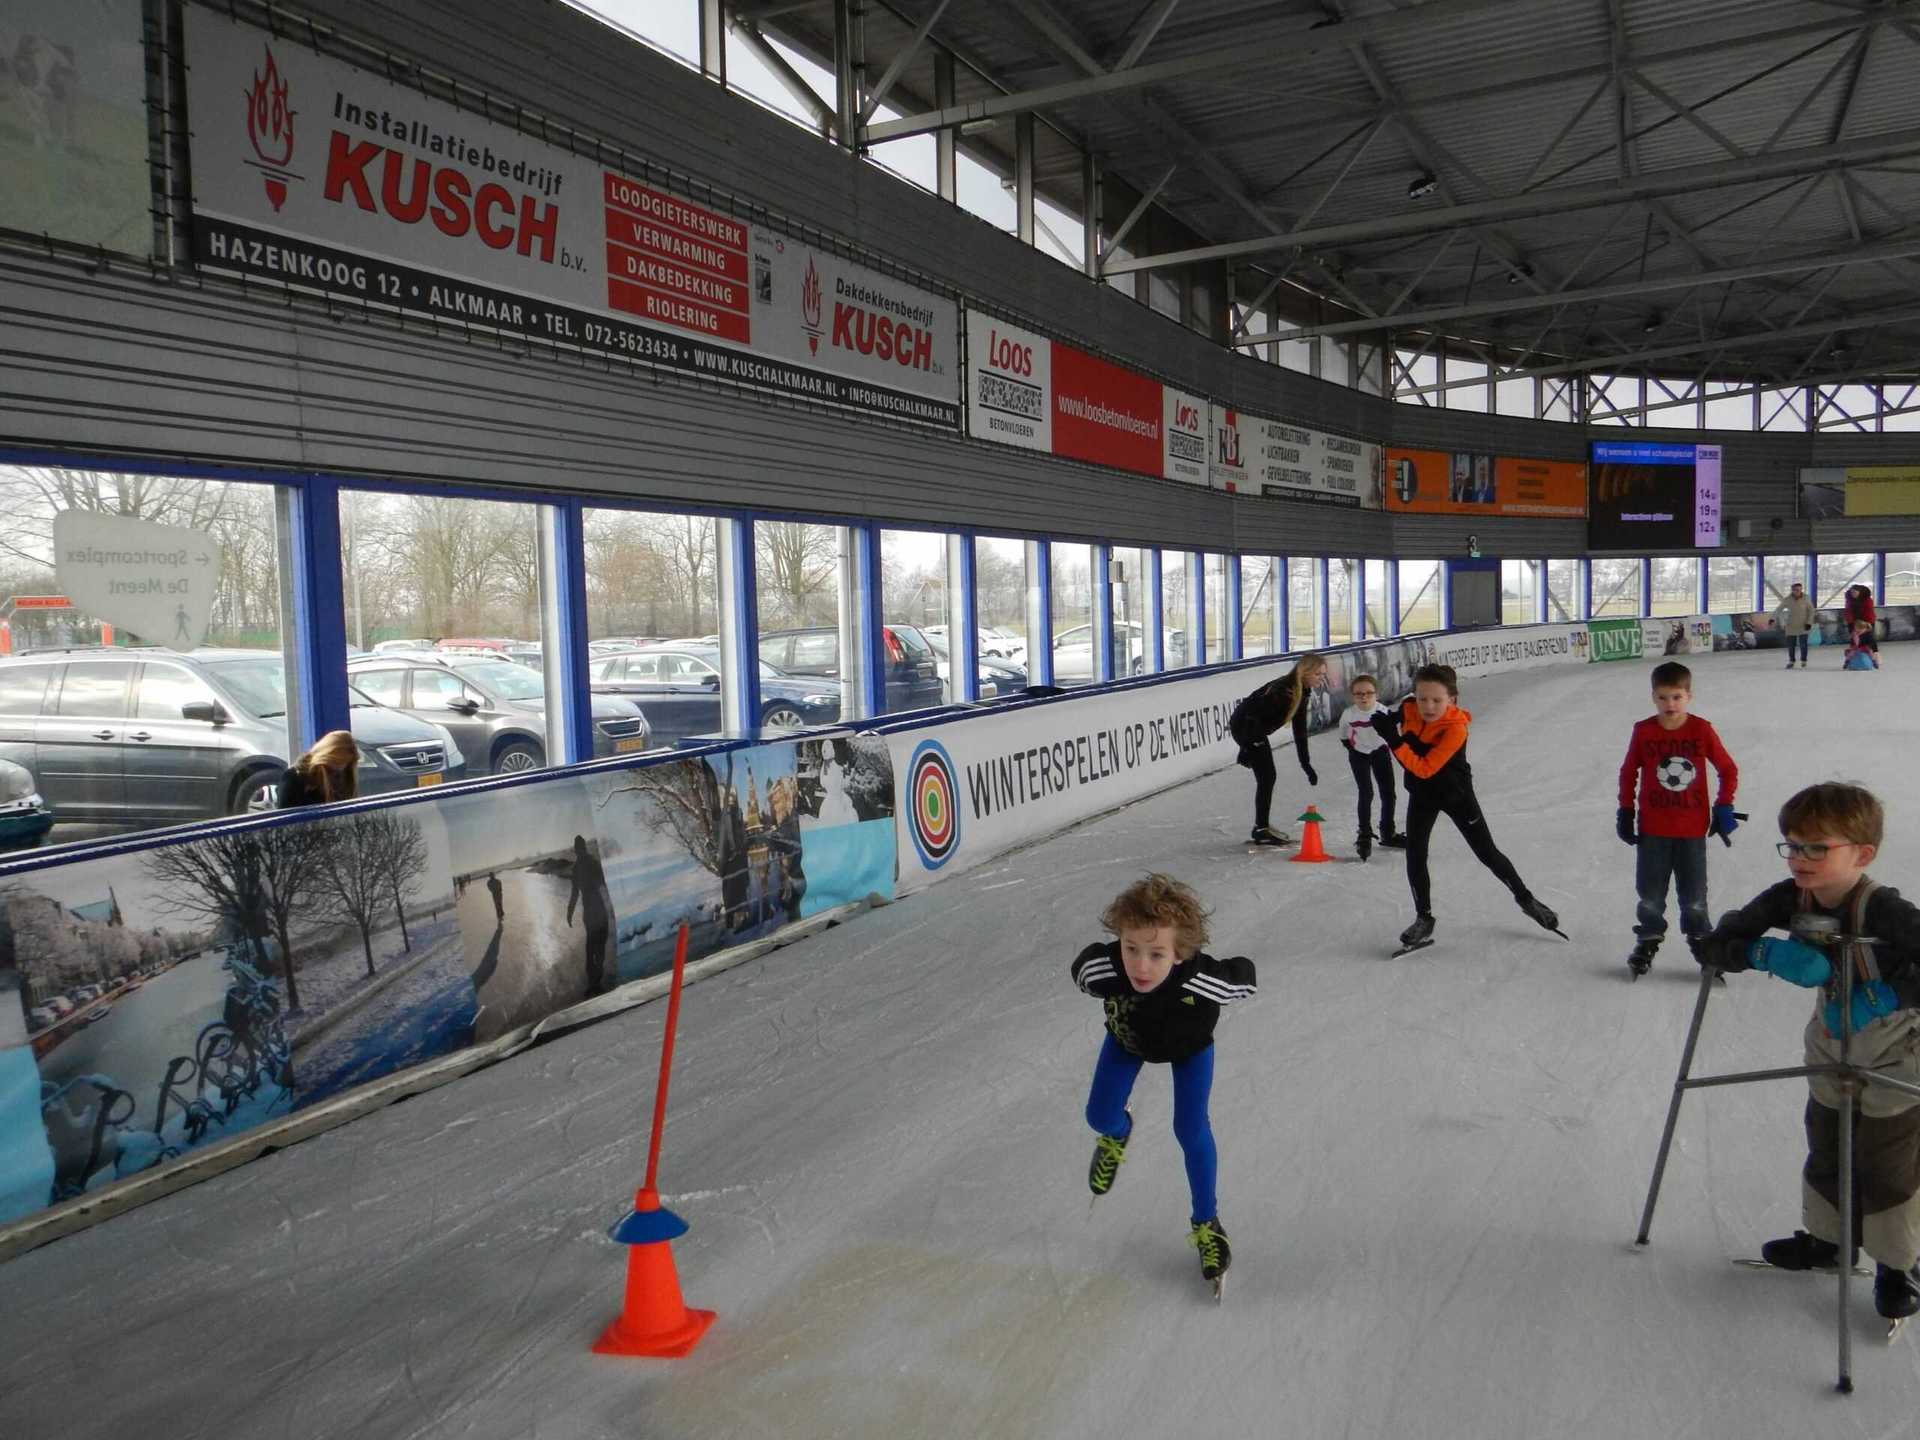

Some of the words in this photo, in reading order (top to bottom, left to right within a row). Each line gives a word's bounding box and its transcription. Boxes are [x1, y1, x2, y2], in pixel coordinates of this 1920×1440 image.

[333, 92, 563, 196] Installatiebedrijf
[323, 130, 559, 264] KUSCH
[611, 181, 742, 247] LOODGIETERSWERK
[560, 247, 587, 274] b.v.
[632, 223, 726, 271] VERWARMING
[626, 256, 733, 304] DAKBEDEKKING
[835, 276, 934, 327] Dakdekkersbedrijf
[209, 230, 367, 291] HAZENKOOG
[377, 271, 402, 298] 12
[429, 284, 524, 326] ALKMAAR
[543, 311, 579, 340] TEL.
[585, 322, 678, 362] 072-5623434
[693, 348, 839, 398] WWW.KUSCHALKMAAR.NL
[848, 386, 957, 424] INFO@KUSCHALKMAAR.NL
[646, 294, 718, 331] RIOLERING
[831, 302, 933, 371] KUSCH
[988, 329, 1033, 378] LOOS
[989, 416, 1035, 439] BETONVLOEREN
[1057, 391, 1160, 441] www.loosbetonvloeren.nl
[1174, 399, 1199, 432] LOOS
[966, 729, 1121, 820] WINTERSPELEN
[1125, 722, 1145, 770] OP
[1148, 718, 1169, 762] DE
[1169, 706, 1214, 757] MEENT
